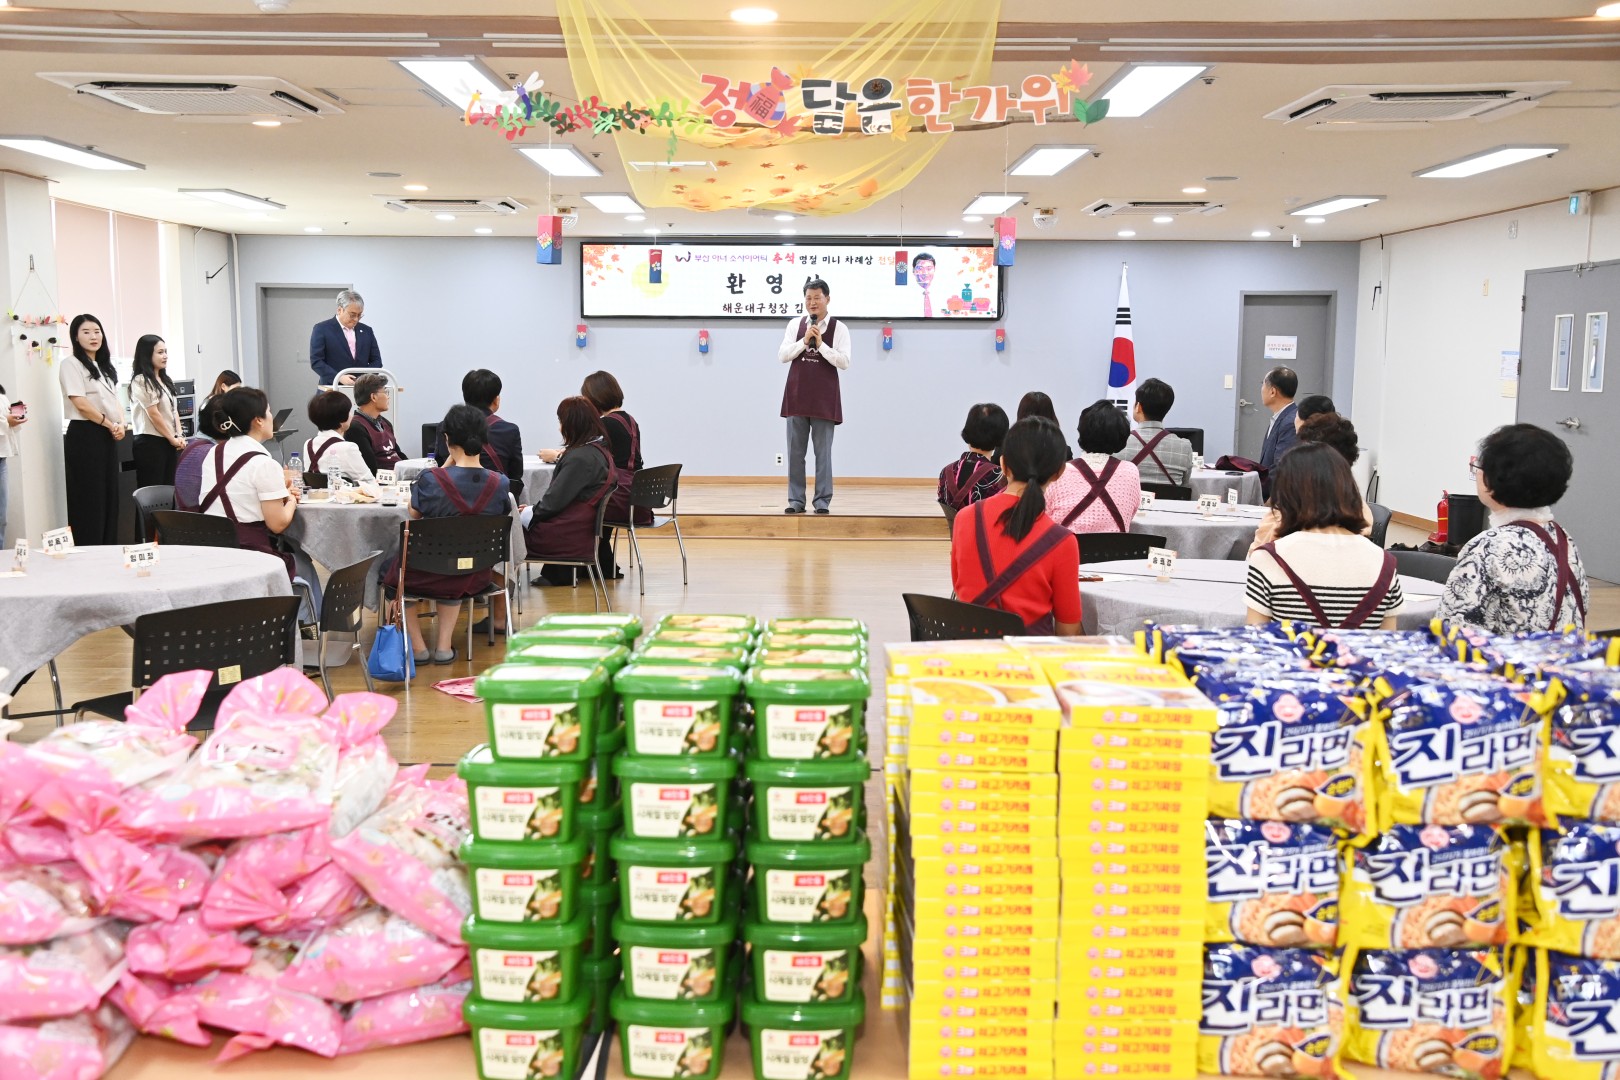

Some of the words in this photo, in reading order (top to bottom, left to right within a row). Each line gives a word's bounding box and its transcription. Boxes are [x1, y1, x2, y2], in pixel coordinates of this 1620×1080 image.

[906, 75, 1071, 133] 한가위
[695, 254, 709, 262] 부산
[712, 254, 727, 262] 아너
[730, 254, 768, 262] 소사이어티
[773, 252, 795, 265] 추석
[799, 255, 817, 265] 명절
[822, 255, 840, 265] 미니
[845, 255, 873, 265] 차례상
[722, 303, 789, 315] 해운대구청장
